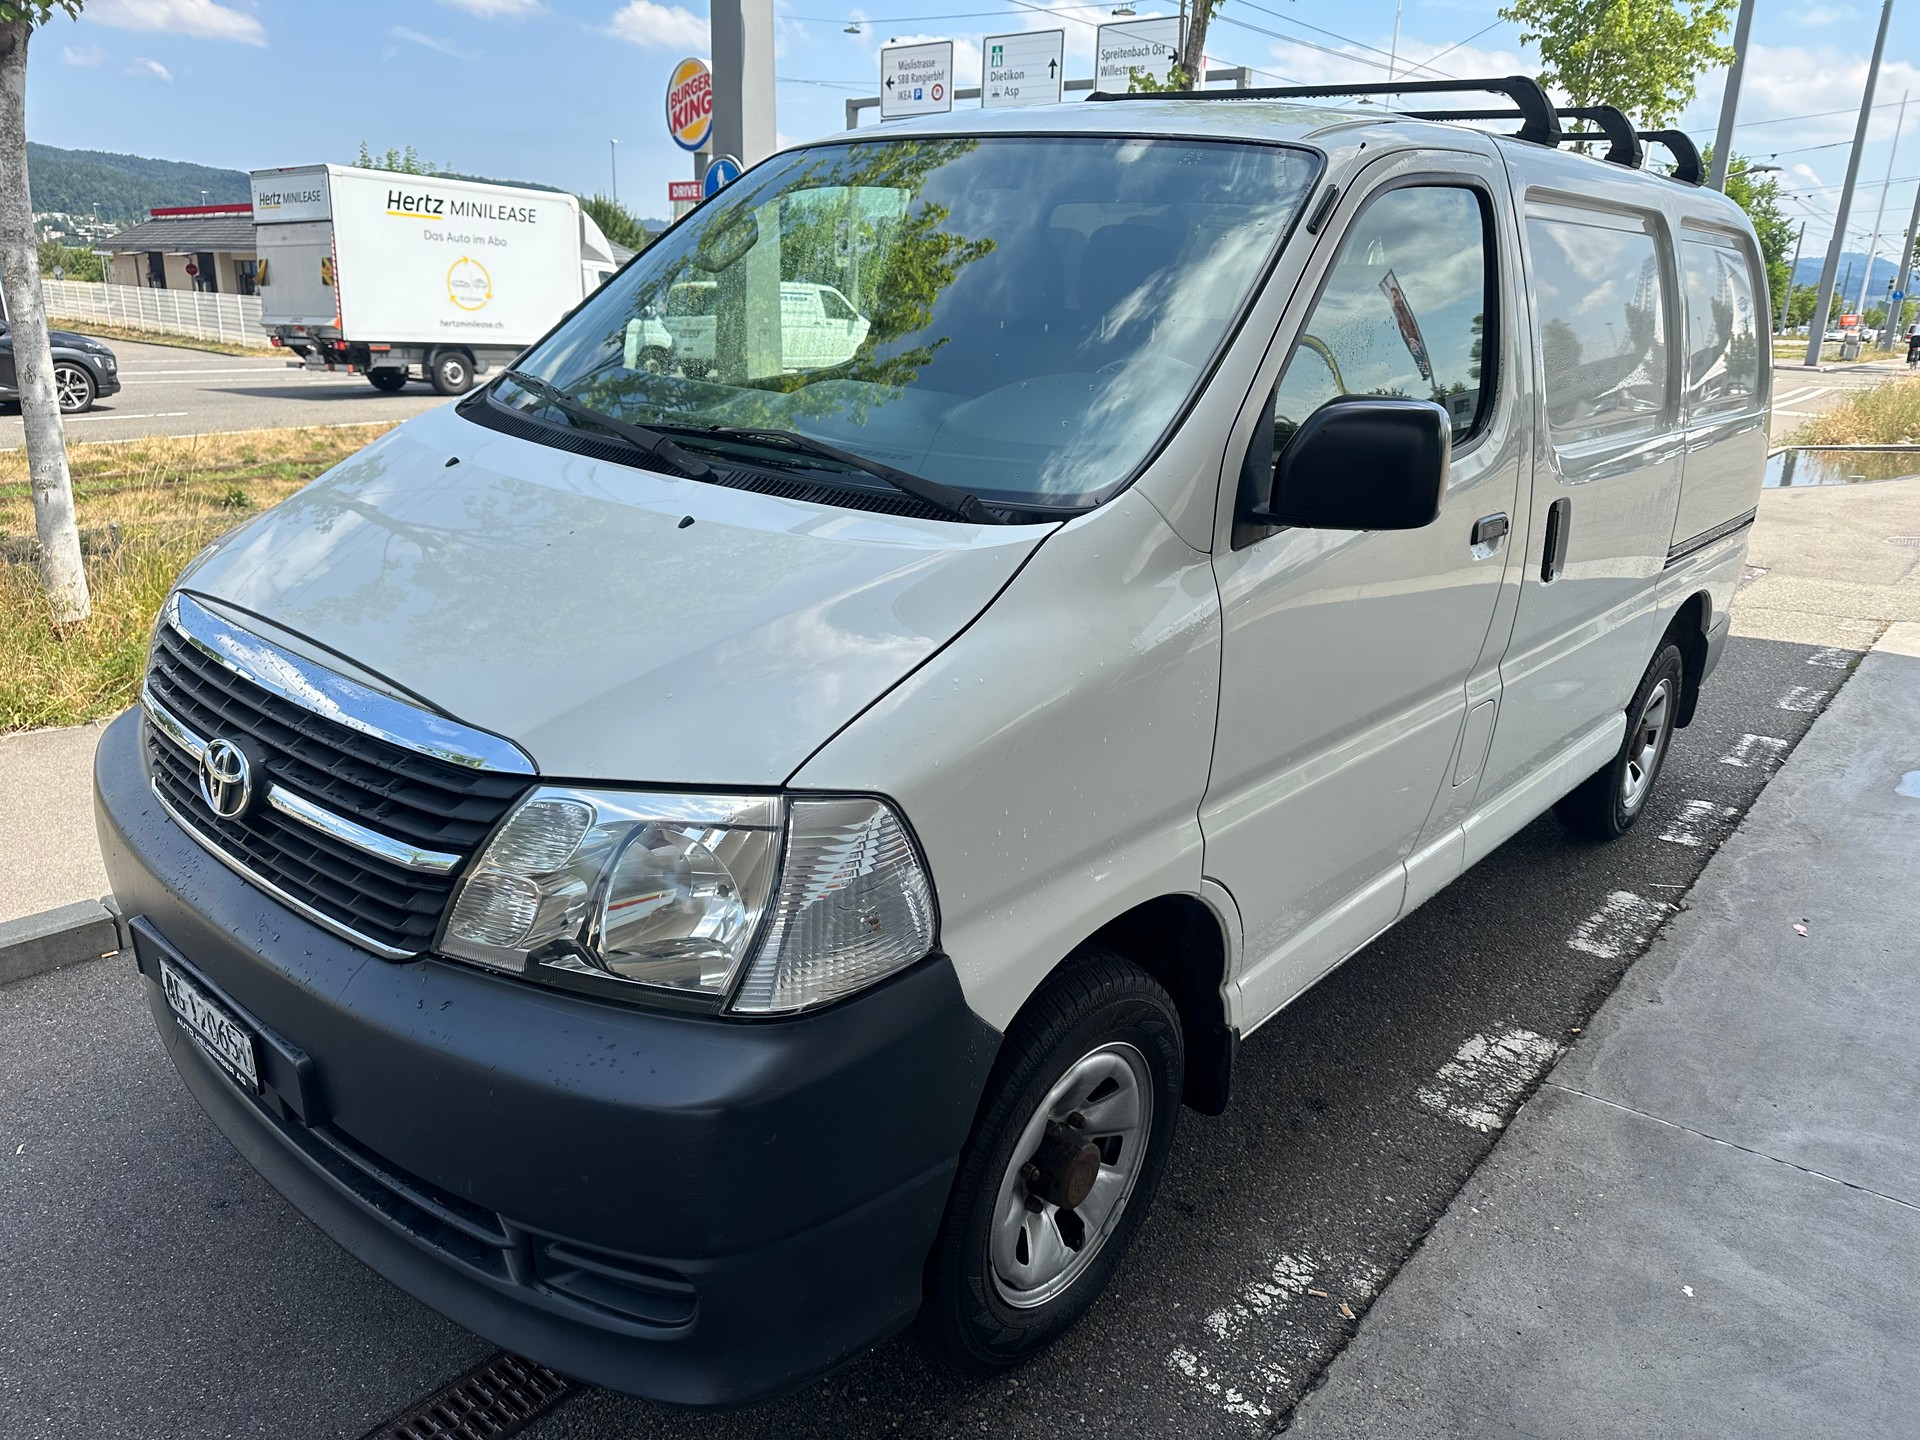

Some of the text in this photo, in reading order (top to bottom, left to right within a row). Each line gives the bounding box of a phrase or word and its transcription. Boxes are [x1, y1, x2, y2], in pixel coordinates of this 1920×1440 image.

[1101, 39, 1166, 62] Spreitenbach Ost
[898, 59, 936, 71] Müslistrasse
[898, 74, 910, 85] SBB
[990, 70, 1025, 82] Dietikon
[670, 72, 711, 111] BURGER
[897, 90, 912, 101] IKEA
[1003, 86, 1020, 99] Asp
[672, 89, 712, 136] KING
[259, 190, 321, 206] Hertz MINILEASE
[672, 185, 698, 198] DRIVE
[386, 189, 537, 224] Hertz MINILEASE
[423, 229, 507, 247] Das Auto im Abo
[439, 318, 504, 330] hertzminilease.ch
[165, 970, 187, 1014] AG
[177, 1016, 194, 1036] AUTO
[236, 1072, 247, 1087] AG
